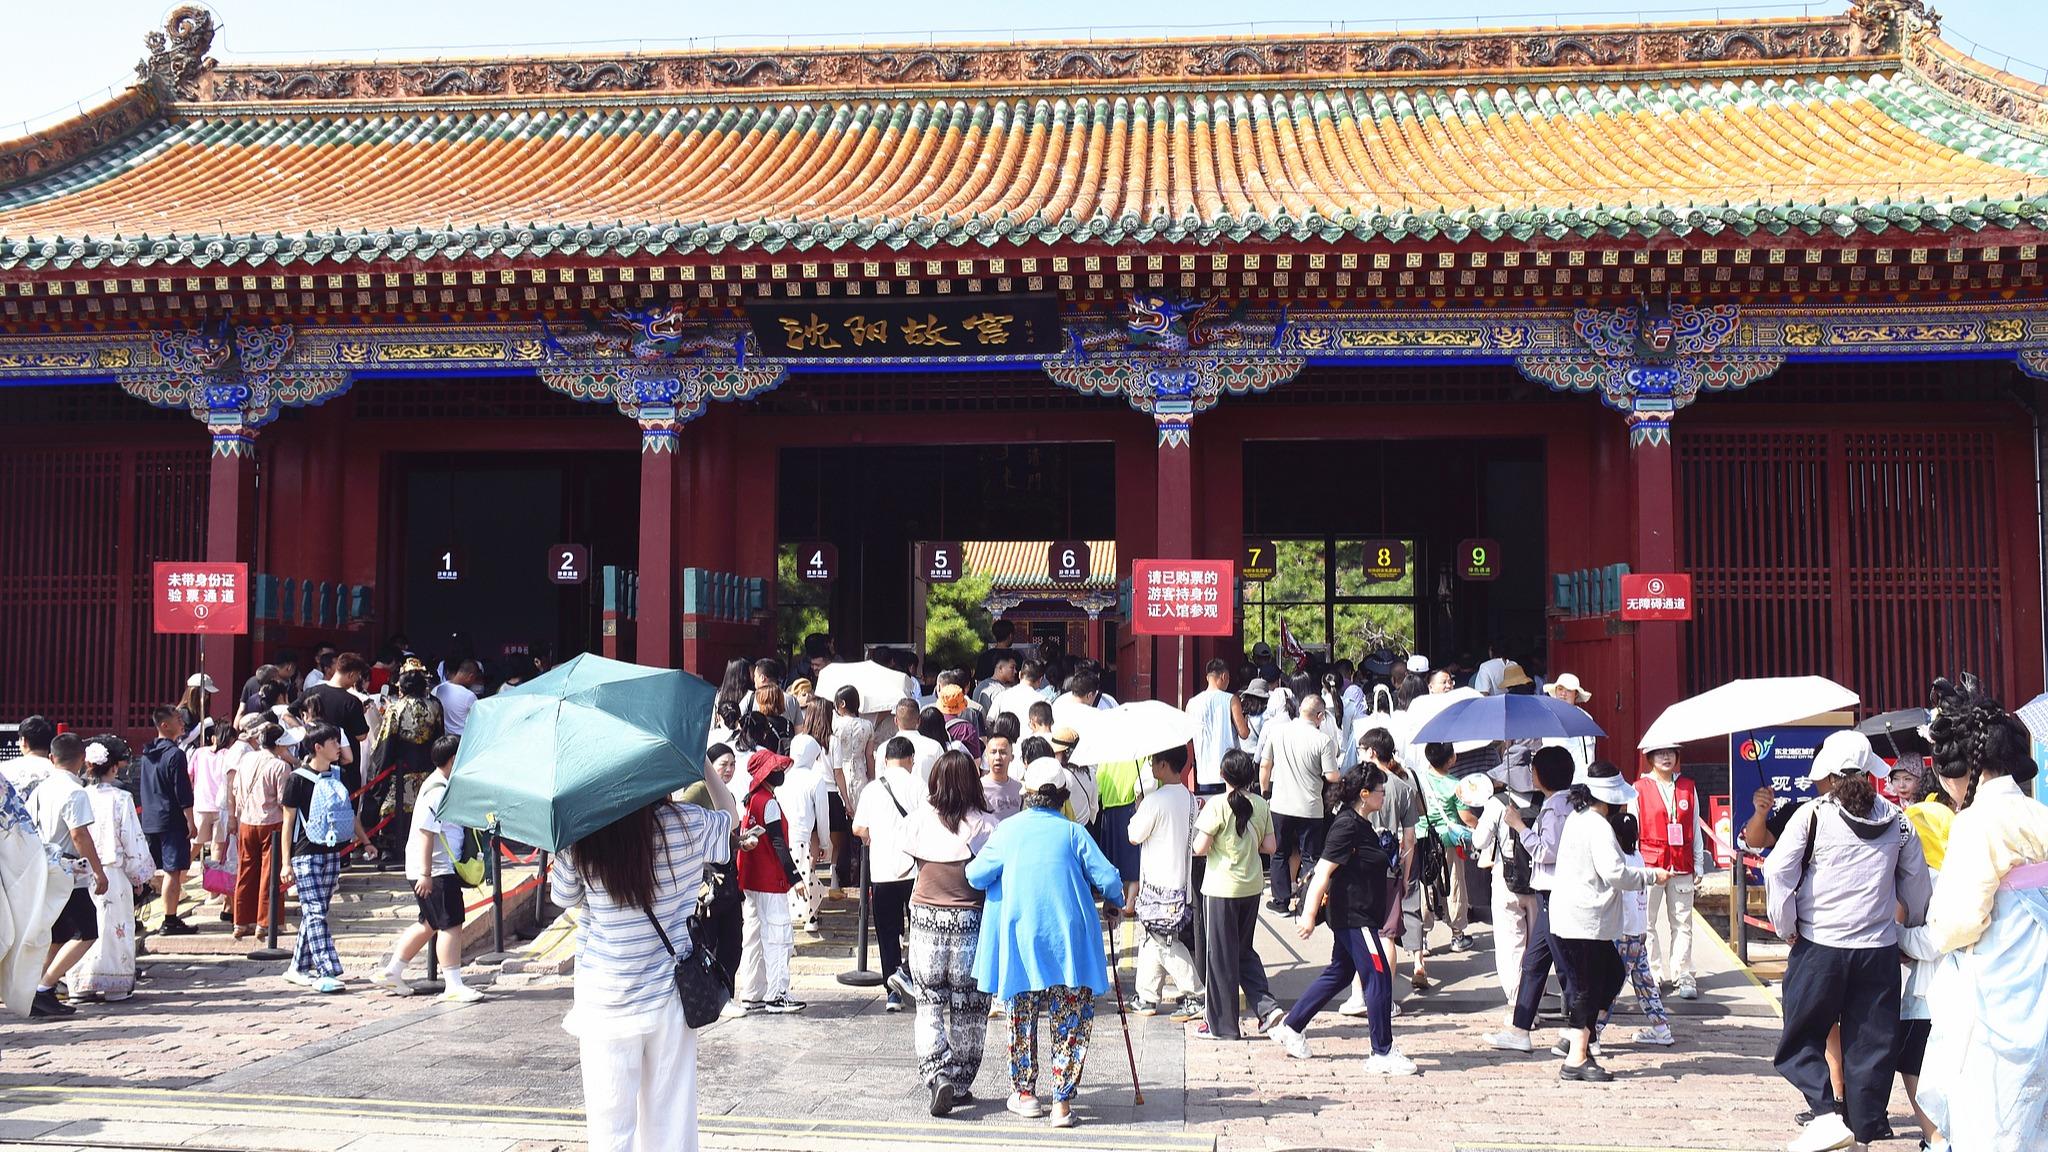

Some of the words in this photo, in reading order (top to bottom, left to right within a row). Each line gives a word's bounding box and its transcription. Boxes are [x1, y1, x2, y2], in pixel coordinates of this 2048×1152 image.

[442, 552, 451, 570] 1
[560, 552, 574, 570] 2
[810, 550, 823, 568] 4
[934, 550, 948, 568] 5
[1062, 549, 1075, 568] 6
[1248, 548, 1261, 567] 7
[1377, 548, 1391, 566] 8
[1472, 547, 1486, 566] 9
[167, 572, 235, 587] 未带身份证
[1147, 570, 1218, 585] 请已购票的
[167, 588, 235, 603] 验票通道
[1147, 587, 1218, 601] 游客持身份
[1147, 603, 1218, 618] 证入馆参观
[1626, 597, 1686, 610] 无障碍通道
